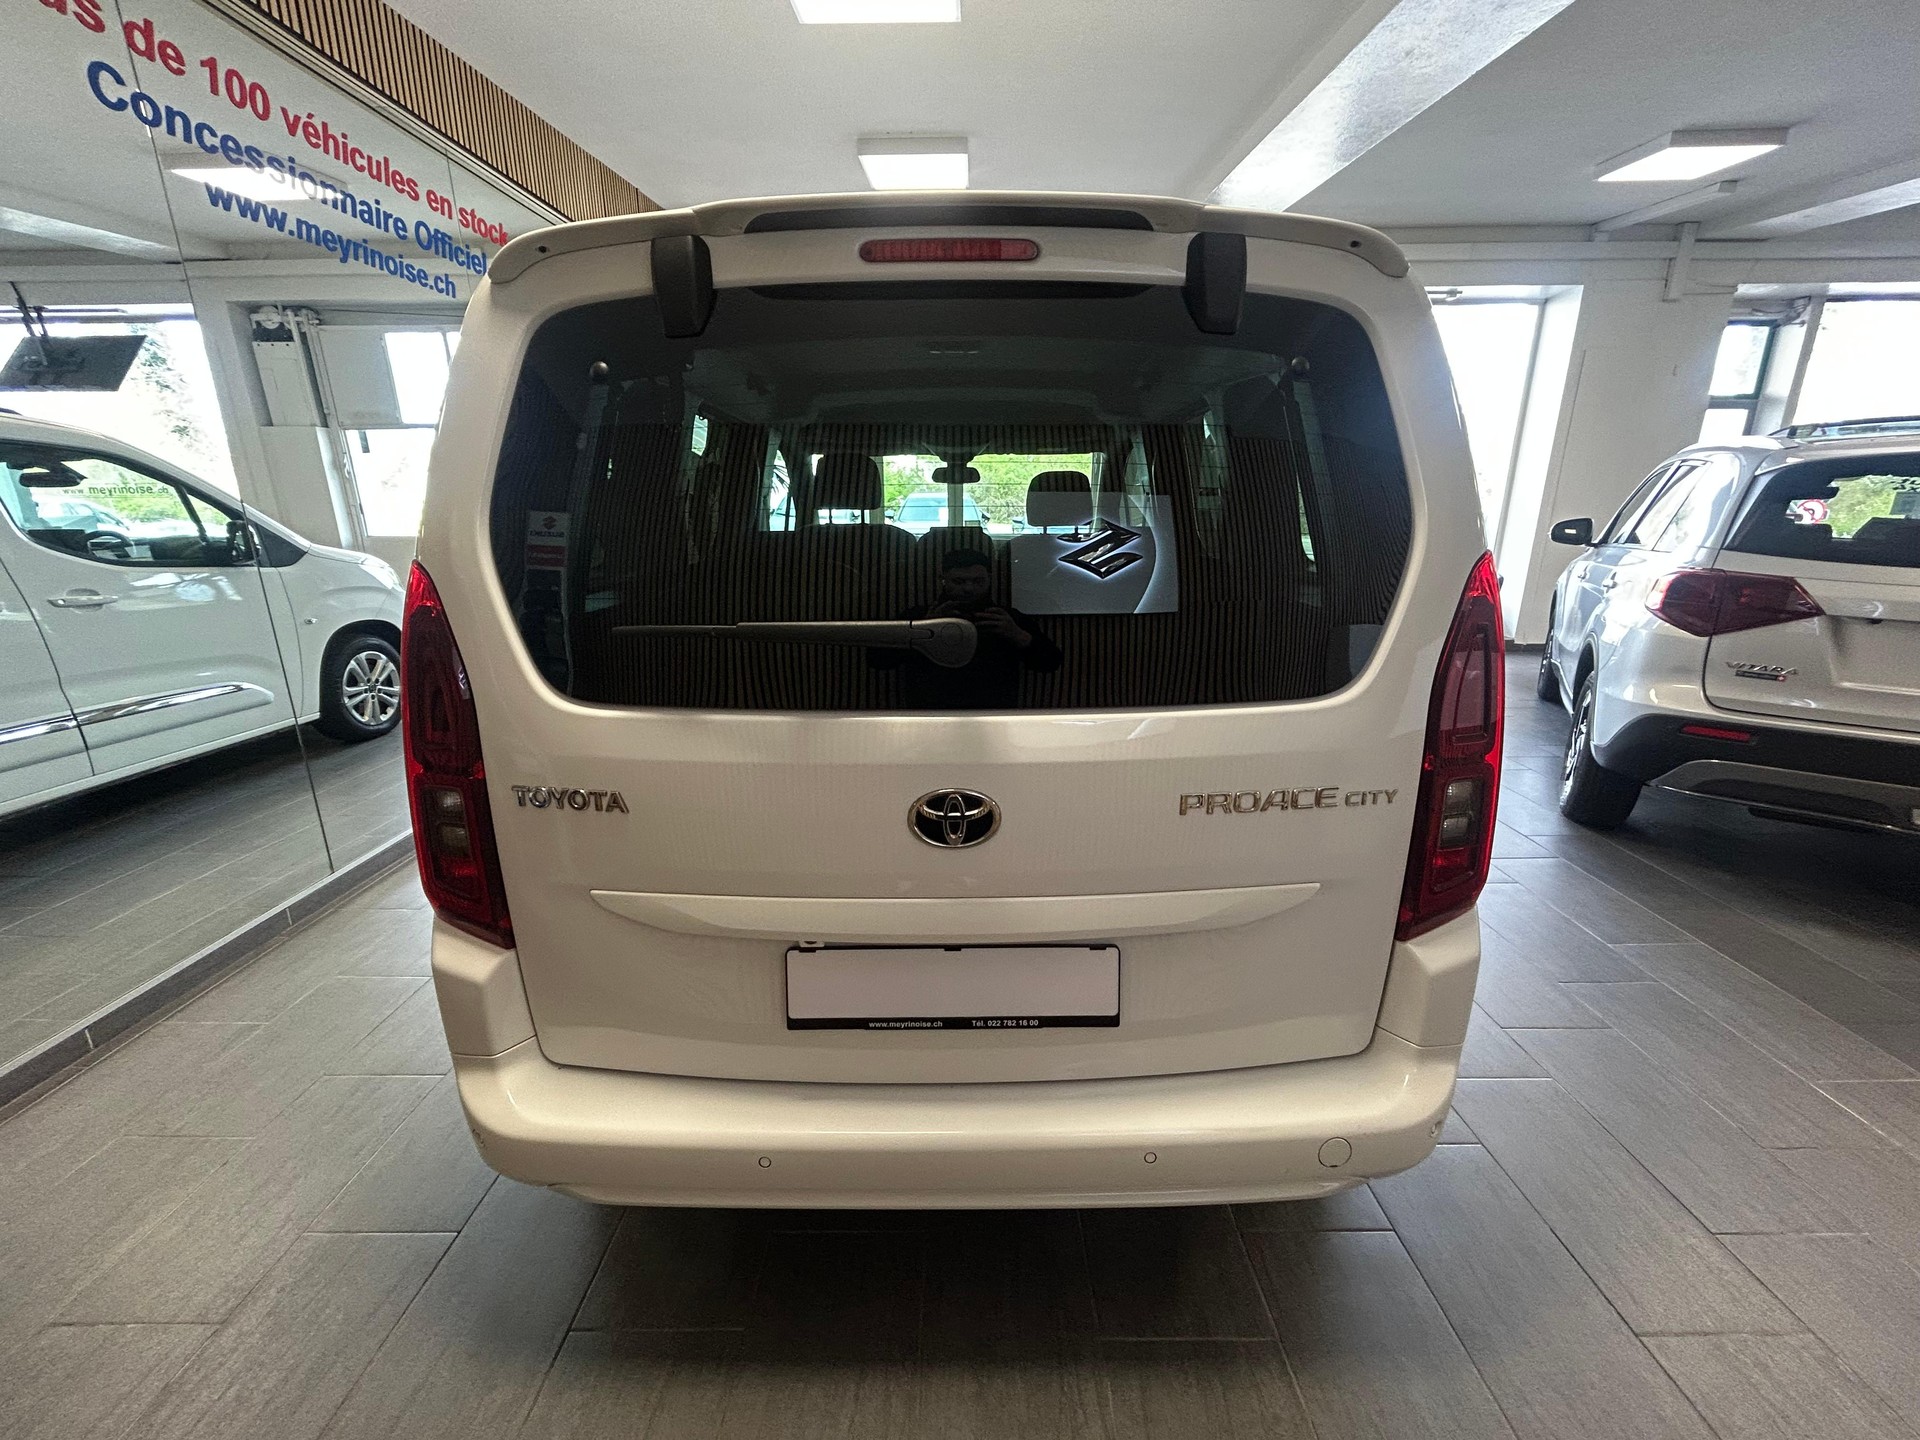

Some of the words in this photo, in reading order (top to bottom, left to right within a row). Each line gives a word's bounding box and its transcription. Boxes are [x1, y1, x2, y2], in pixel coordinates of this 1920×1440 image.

[87, 60, 408, 241] Concessionnaire
[414, 220, 488, 277] Officiel
[123, 17, 187, 77] de
[200, 56, 271, 122] 100
[280, 106, 420, 201] véhicules
[426, 189, 453, 220] en
[458, 206, 509, 248] stock
[204, 181, 457, 299] www.meyrinoise.ch
[511, 784, 630, 814] TOYOTA
[1179, 784, 1340, 816] PROACE
[1345, 788, 1398, 807] CITY
[868, 1020, 943, 1029] www.meyrinoise.ch
[987, 1019, 1001, 1027] 022
[1003, 1019, 1017, 1027] 782
[1018, 1019, 1028, 1027] 16
[1029, 1019, 1039, 1027] 00
